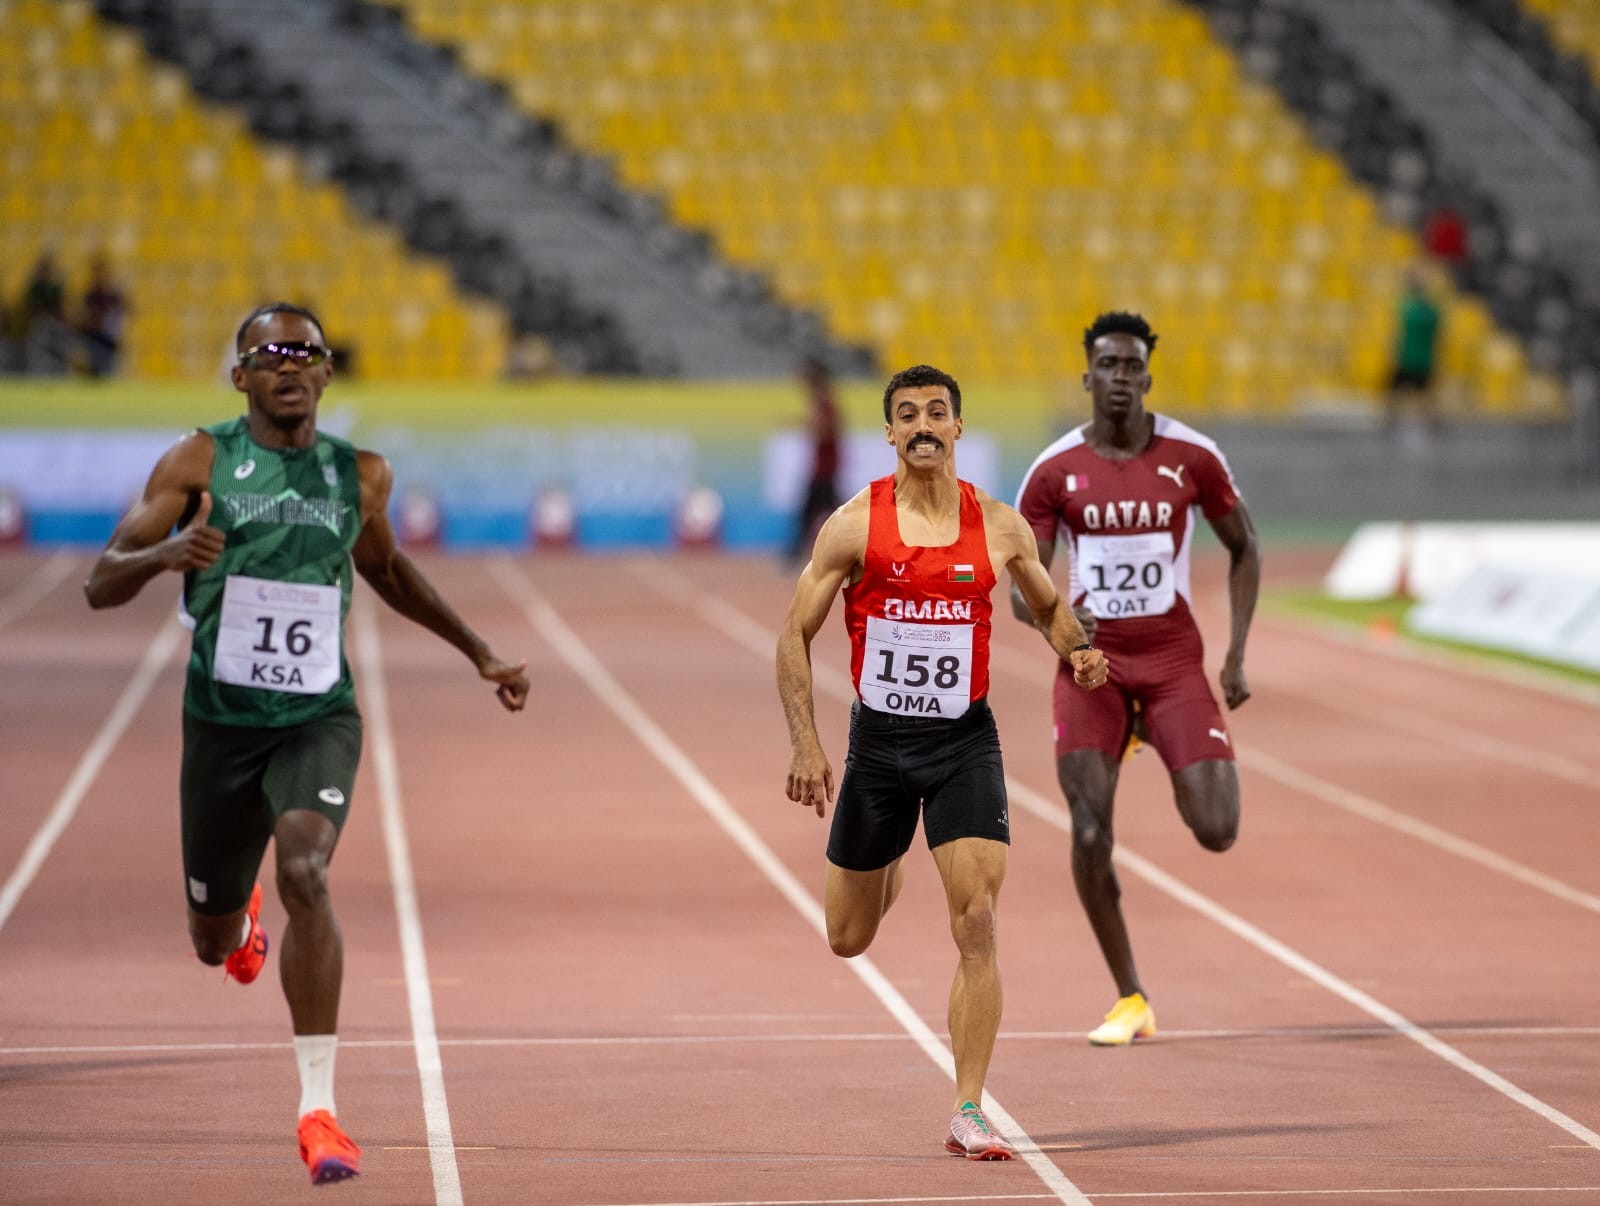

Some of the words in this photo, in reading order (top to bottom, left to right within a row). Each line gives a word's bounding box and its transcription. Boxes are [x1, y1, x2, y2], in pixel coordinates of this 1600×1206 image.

[225, 491, 280, 523] SAUDI
[1083, 501, 1173, 529] QATAR
[1090, 562, 1163, 592] 120
[884, 598, 972, 621] OMAN
[1107, 598, 1149, 614] QAT
[253, 616, 313, 656] 16
[251, 663, 303, 686] KSA
[876, 649, 960, 689] 158
[885, 692, 942, 714] OMA
